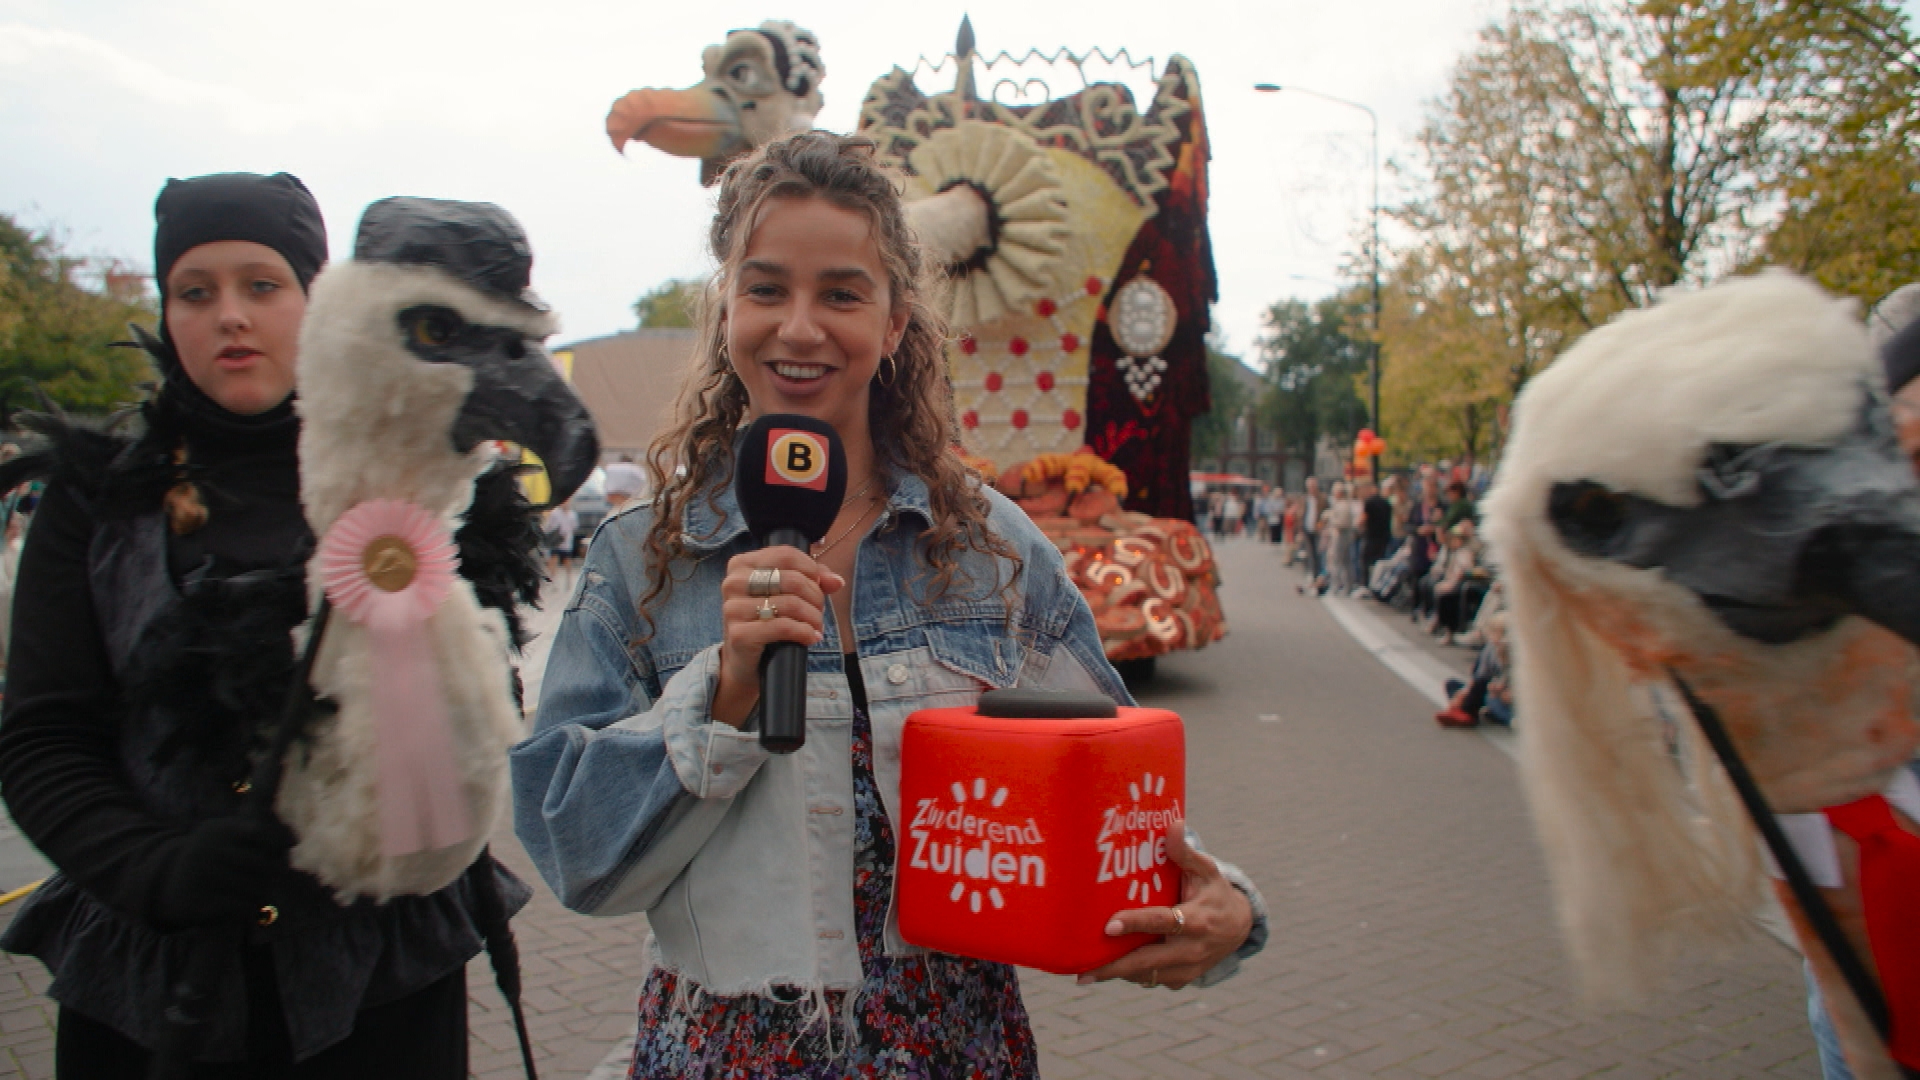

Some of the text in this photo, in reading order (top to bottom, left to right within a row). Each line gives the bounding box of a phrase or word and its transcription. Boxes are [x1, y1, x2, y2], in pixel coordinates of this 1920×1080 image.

[787, 441, 812, 472] B
[909, 798, 1045, 845] Zinderend
[1096, 799, 1182, 844] Zinderend
[909, 830, 1045, 887] Zuiden
[1096, 830, 1167, 883] Zuide
